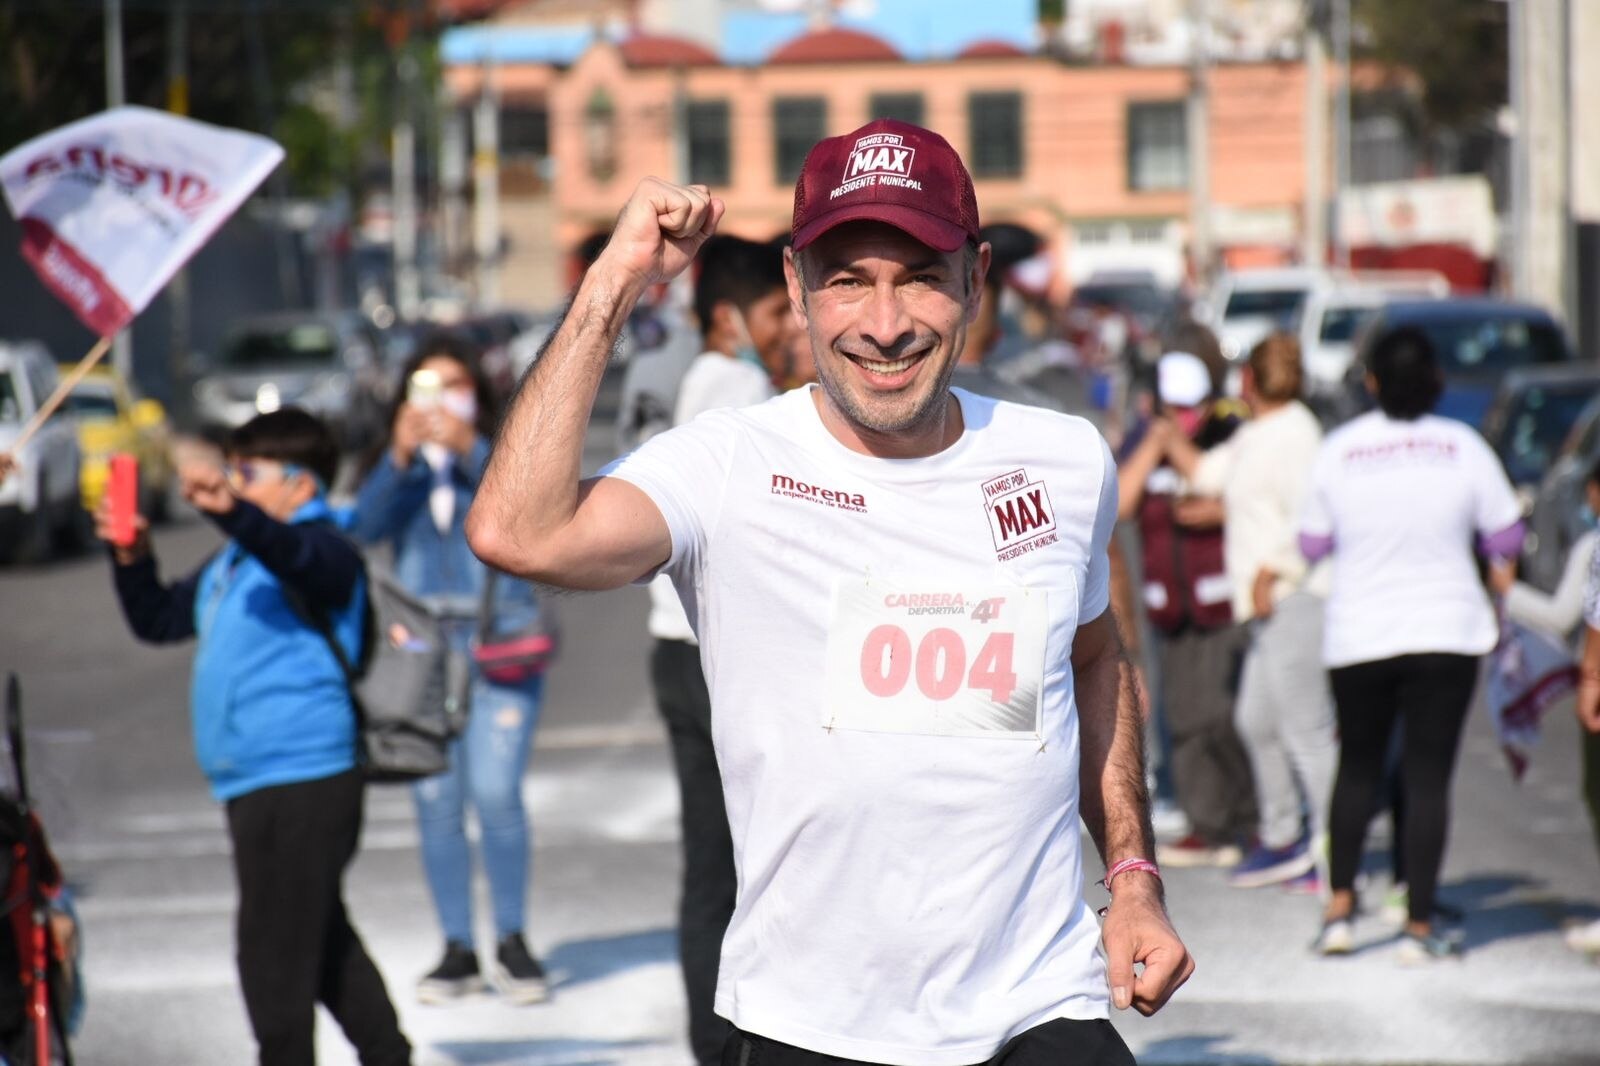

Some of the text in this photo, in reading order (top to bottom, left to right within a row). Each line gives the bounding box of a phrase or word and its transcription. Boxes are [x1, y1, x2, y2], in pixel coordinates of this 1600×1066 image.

[858, 136, 899, 148] VAMOS POR
[851, 148, 908, 176] MAX
[830, 176, 922, 200] PRESIDENTE MUNICIPAL
[772, 474, 866, 507] morena
[985, 473, 1025, 497] VAMOS POR
[994, 489, 1050, 541] MAX
[998, 543, 1034, 562] PRESIDENTE
[884, 593, 964, 608] CARRERA
[908, 606, 965, 615] DEPORTIVA
[970, 597, 1006, 624] 4T
[860, 624, 1017, 704] 004
